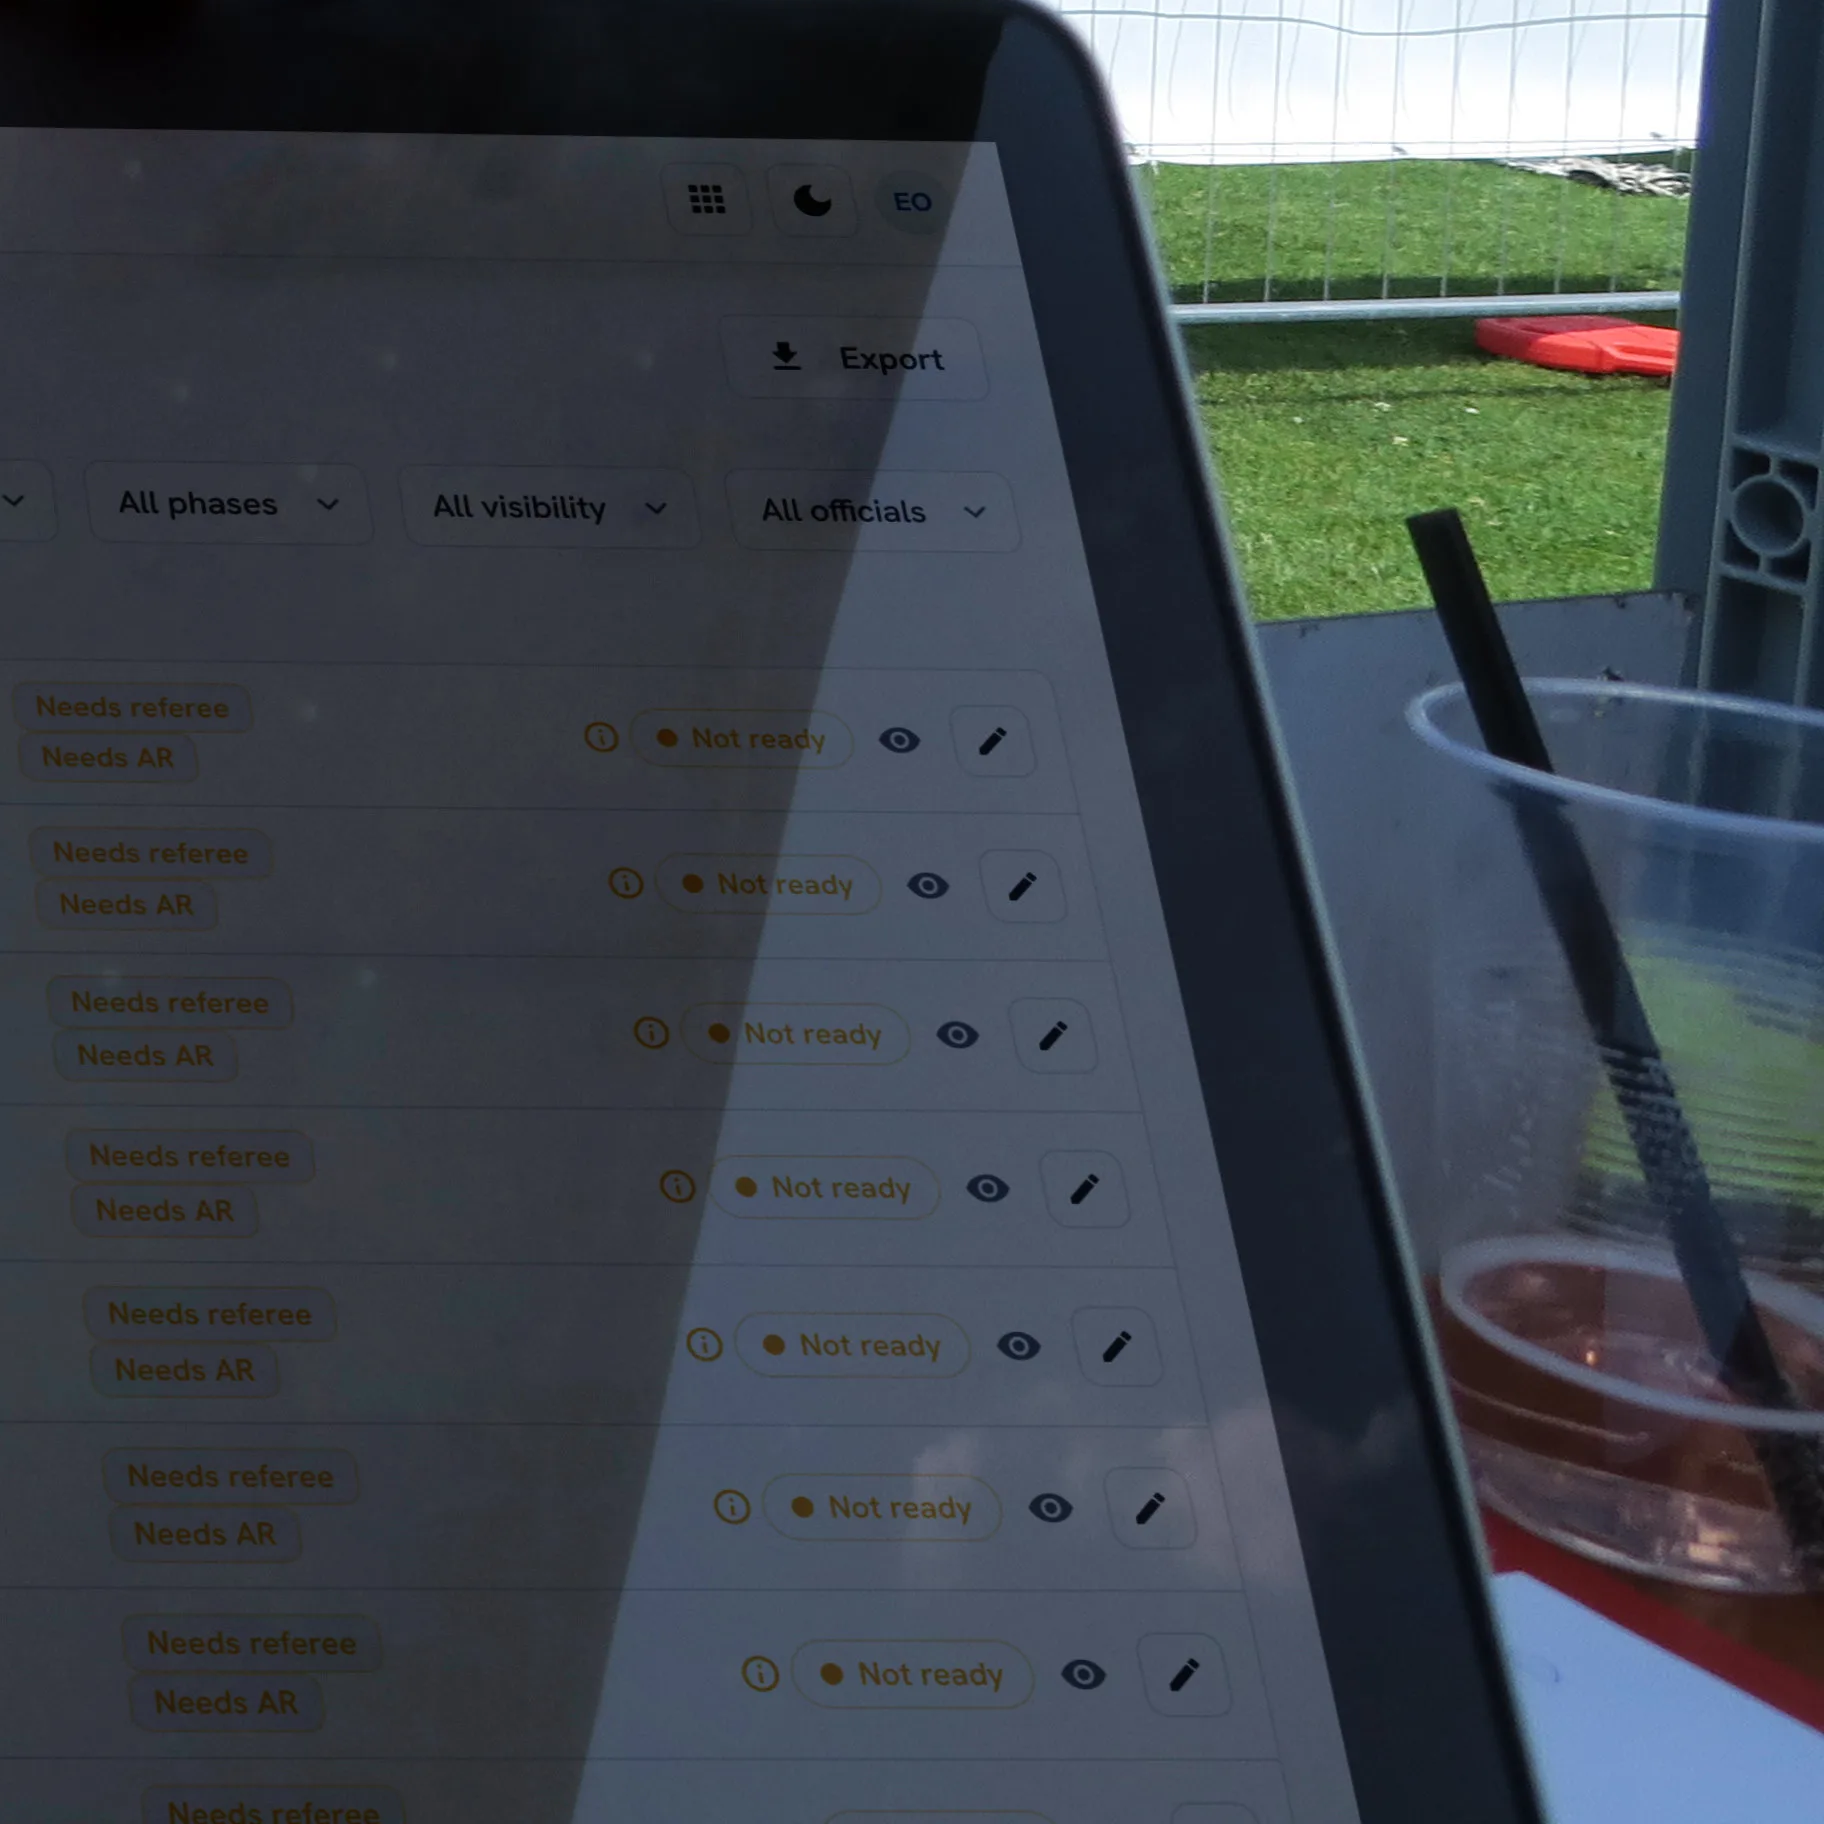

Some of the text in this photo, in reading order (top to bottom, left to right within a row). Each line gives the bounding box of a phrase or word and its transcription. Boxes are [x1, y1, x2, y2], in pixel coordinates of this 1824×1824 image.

[893, 191, 933, 212] EO
[840, 346, 946, 376] Export
[119, 490, 278, 521] All phases
[433, 493, 606, 526] All visibility
[762, 497, 927, 524] All officials
[828, 1495, 973, 1526] Not ready
[857, 1661, 1004, 1694] Not ready
